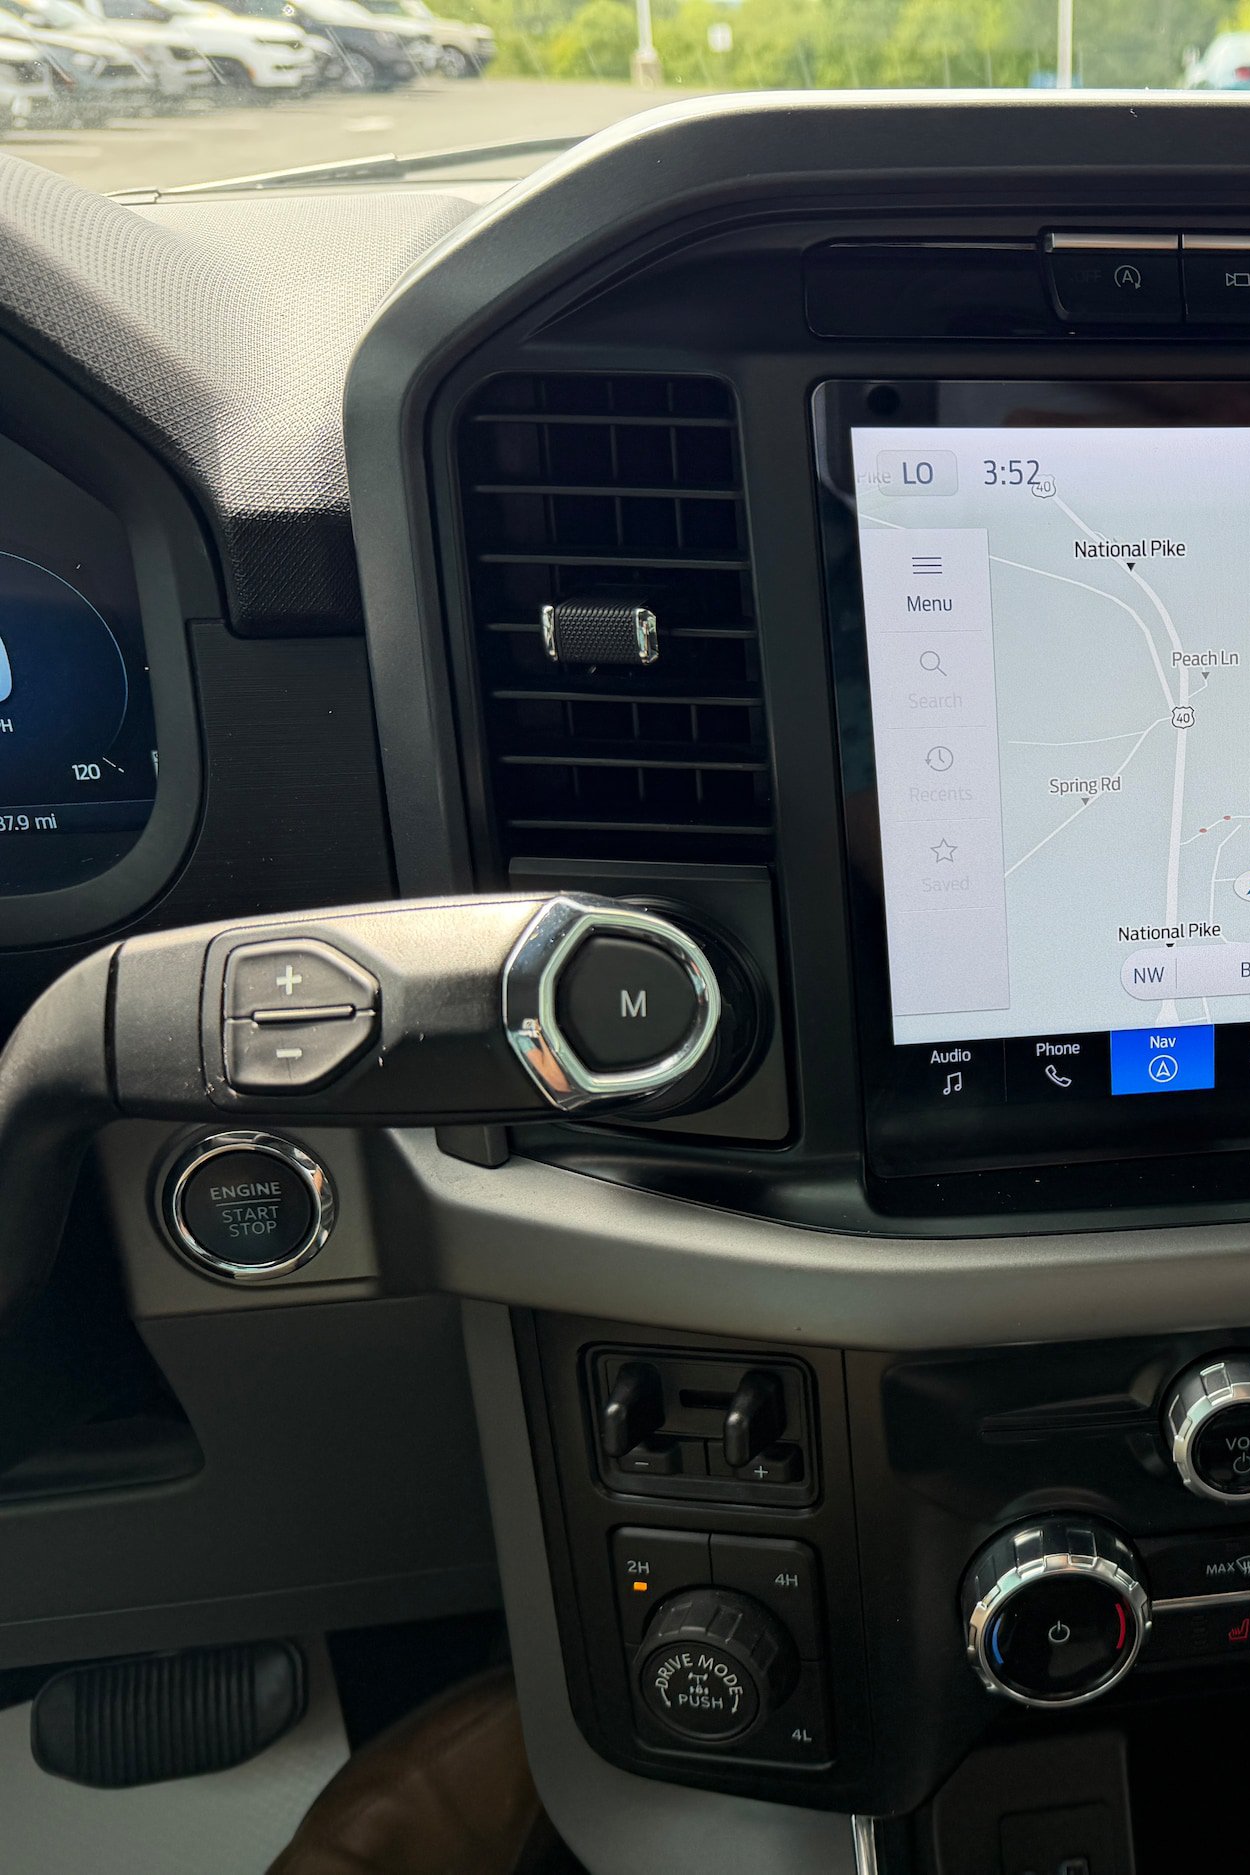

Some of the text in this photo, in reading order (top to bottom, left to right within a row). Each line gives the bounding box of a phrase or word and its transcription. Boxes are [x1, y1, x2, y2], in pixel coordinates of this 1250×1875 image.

[902, 461, 934, 485] LO
[983, 459, 1041, 486] 3:52
[1075, 539, 1186, 558] National Pike
[906, 595, 953, 612] Menu
[1172, 650, 1240, 667] Peach Ln
[907, 692, 963, 710] Search
[0, 717, 15, 733] H
[1173, 712, 1191, 724] 40
[71, 763, 101, 781] 120
[908, 786, 973, 803] Recents
[1049, 776, 1121, 796] Spring Rd
[34, 812, 58, 830] mi
[921, 875, 970, 893] Saved
[1118, 922, 1221, 942] National Pike
[1134, 966, 1165, 985] NW
[620, 989, 647, 1018] M
[1035, 1042, 1081, 1057] Phone
[1149, 1035, 1177, 1049] Nav
[930, 1048, 972, 1064] Audio
[210, 1181, 282, 1200] ENGINE
[222, 1205, 279, 1223] START
[229, 1220, 278, 1238] STOP
[627, 1560, 650, 1574] 2H
[1206, 1561, 1236, 1575] MAX
[774, 1573, 799, 1587] 4H
[654, 1652, 744, 1696] DRIVE MODE
[678, 1691, 724, 1709] PUSH
[791, 1728, 812, 1742] 4L
